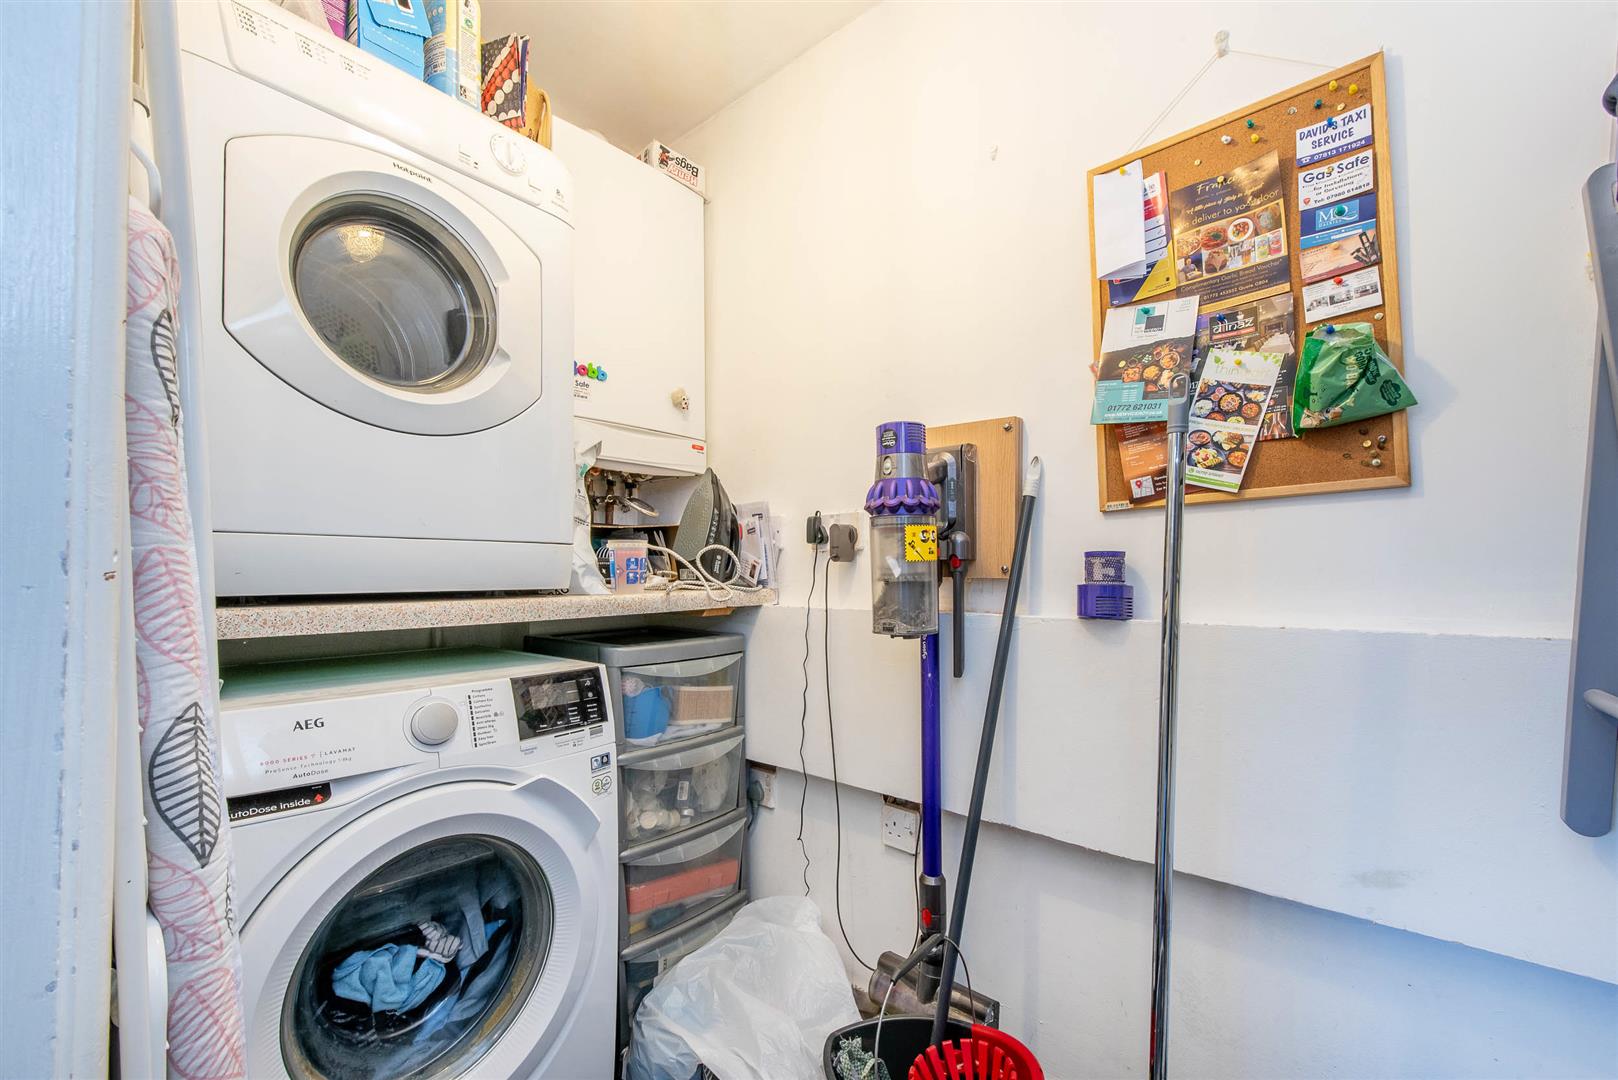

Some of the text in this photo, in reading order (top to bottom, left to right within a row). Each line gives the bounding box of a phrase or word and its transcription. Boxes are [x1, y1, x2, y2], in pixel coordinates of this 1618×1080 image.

[1299, 108, 1367, 141] DAVIDS TAXI
[1311, 126, 1354, 149] SERVICE
[392, 161, 432, 183] Hotpoint
[674, 156, 699, 178] Bags
[1336, 155, 1370, 174] Safe
[1191, 211, 1221, 225] deliver
[1223, 207, 1233, 216] to
[1107, 402, 1162, 412] 01772 621031
[293, 717, 325, 732] AEG
[324, 747, 356, 756] LAVAMAT
[292, 769, 330, 780] AutoDose
[228, 803, 278, 820] utoDose
